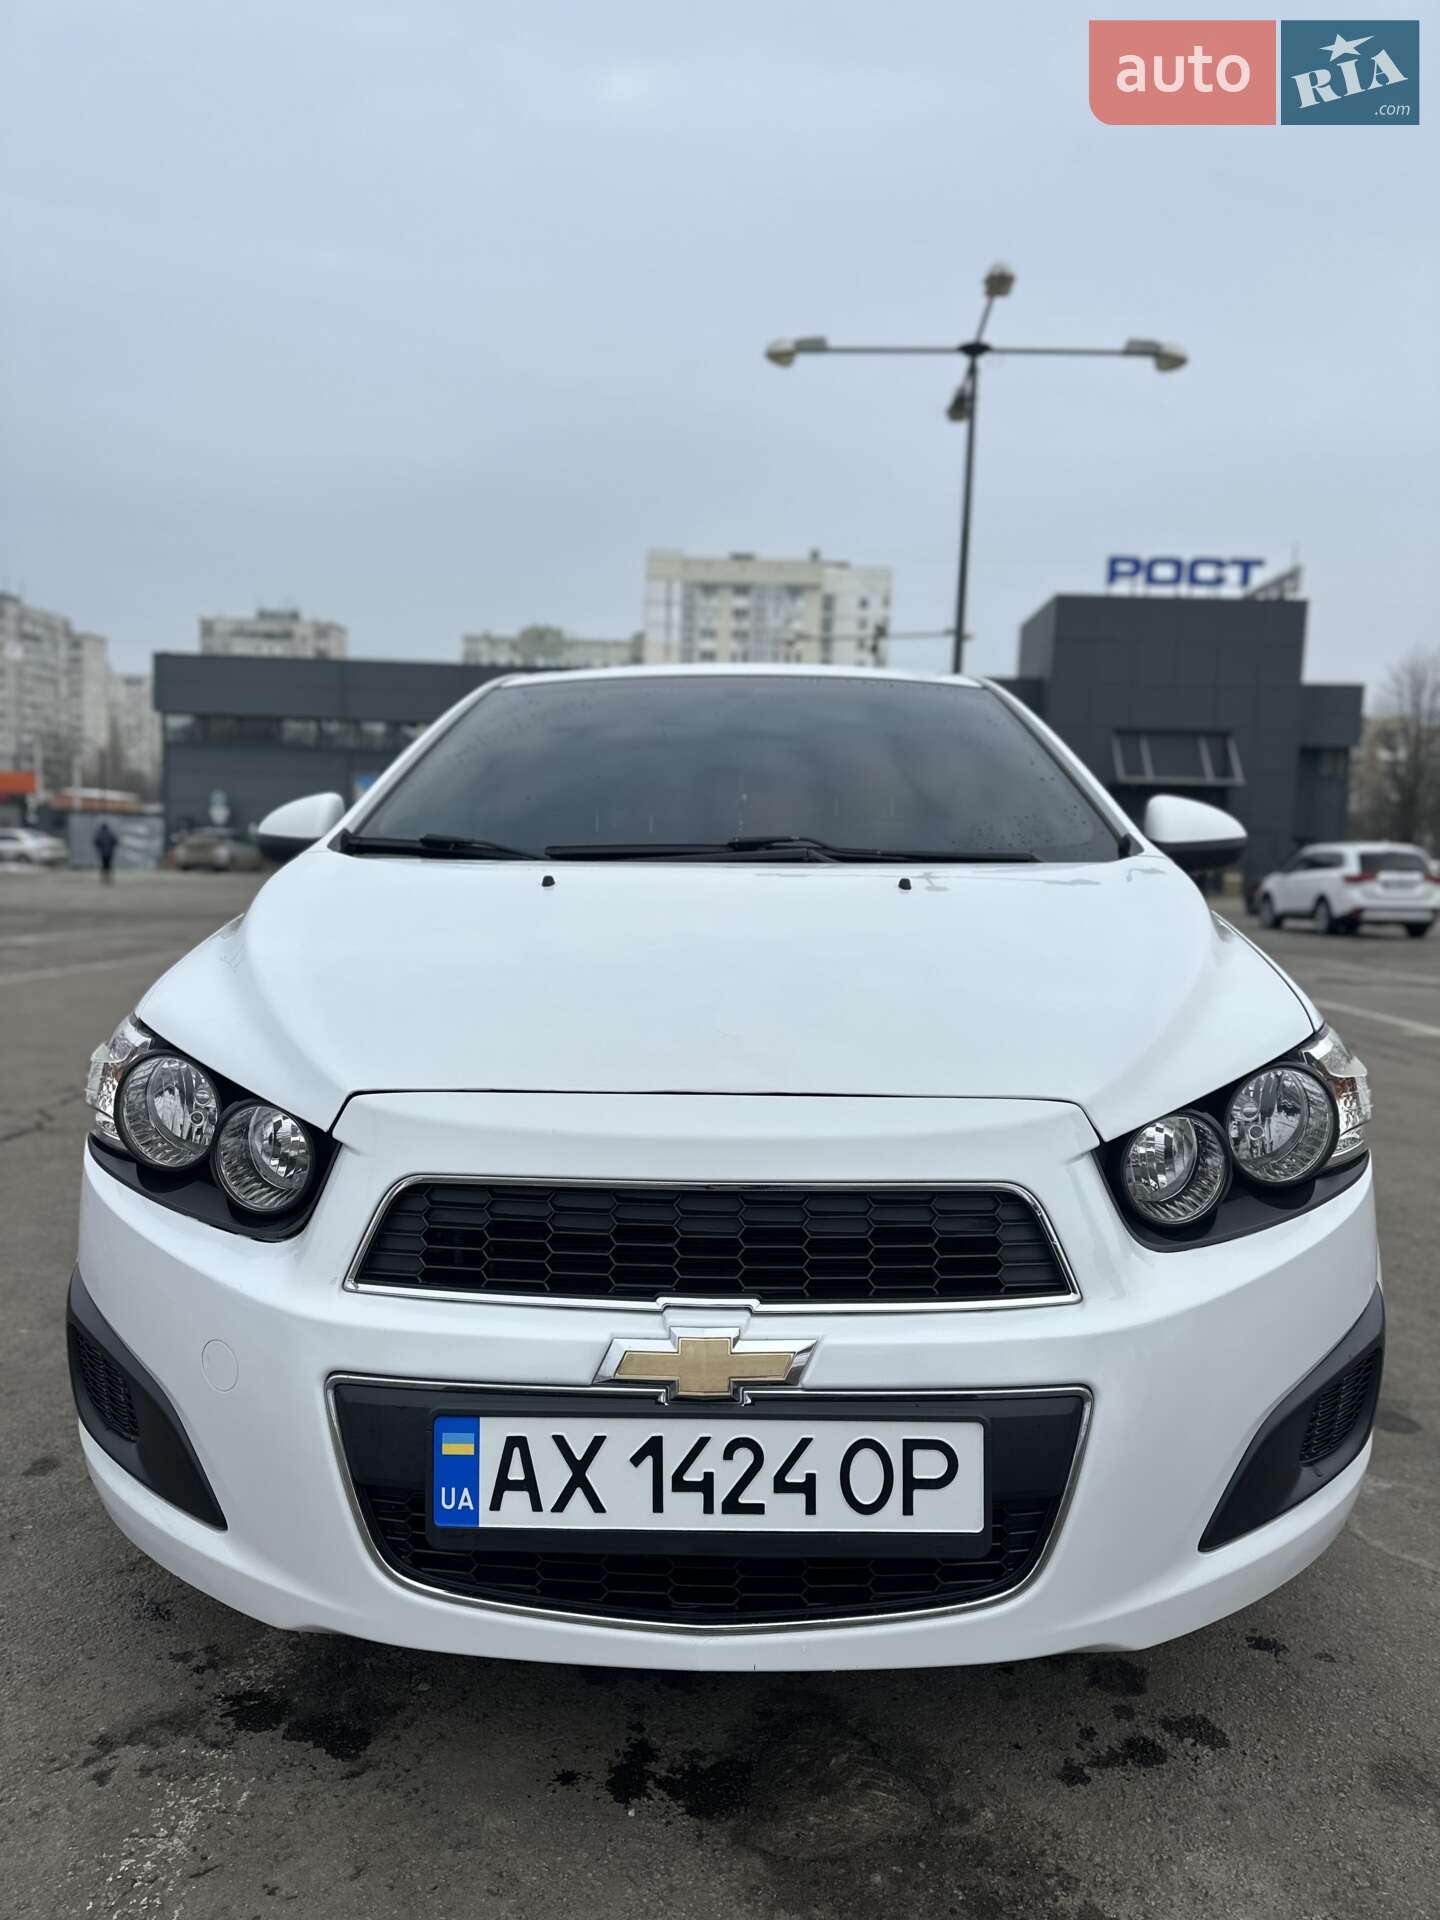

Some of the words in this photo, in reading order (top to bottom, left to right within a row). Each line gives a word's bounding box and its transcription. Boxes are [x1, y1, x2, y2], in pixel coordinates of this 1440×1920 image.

[1107, 556, 1266, 587] РОСТ
[489, 1434, 607, 1514] AX
[629, 1435, 817, 1516] 1424
[839, 1437, 959, 1517] OP
[440, 1486, 474, 1511] UA
